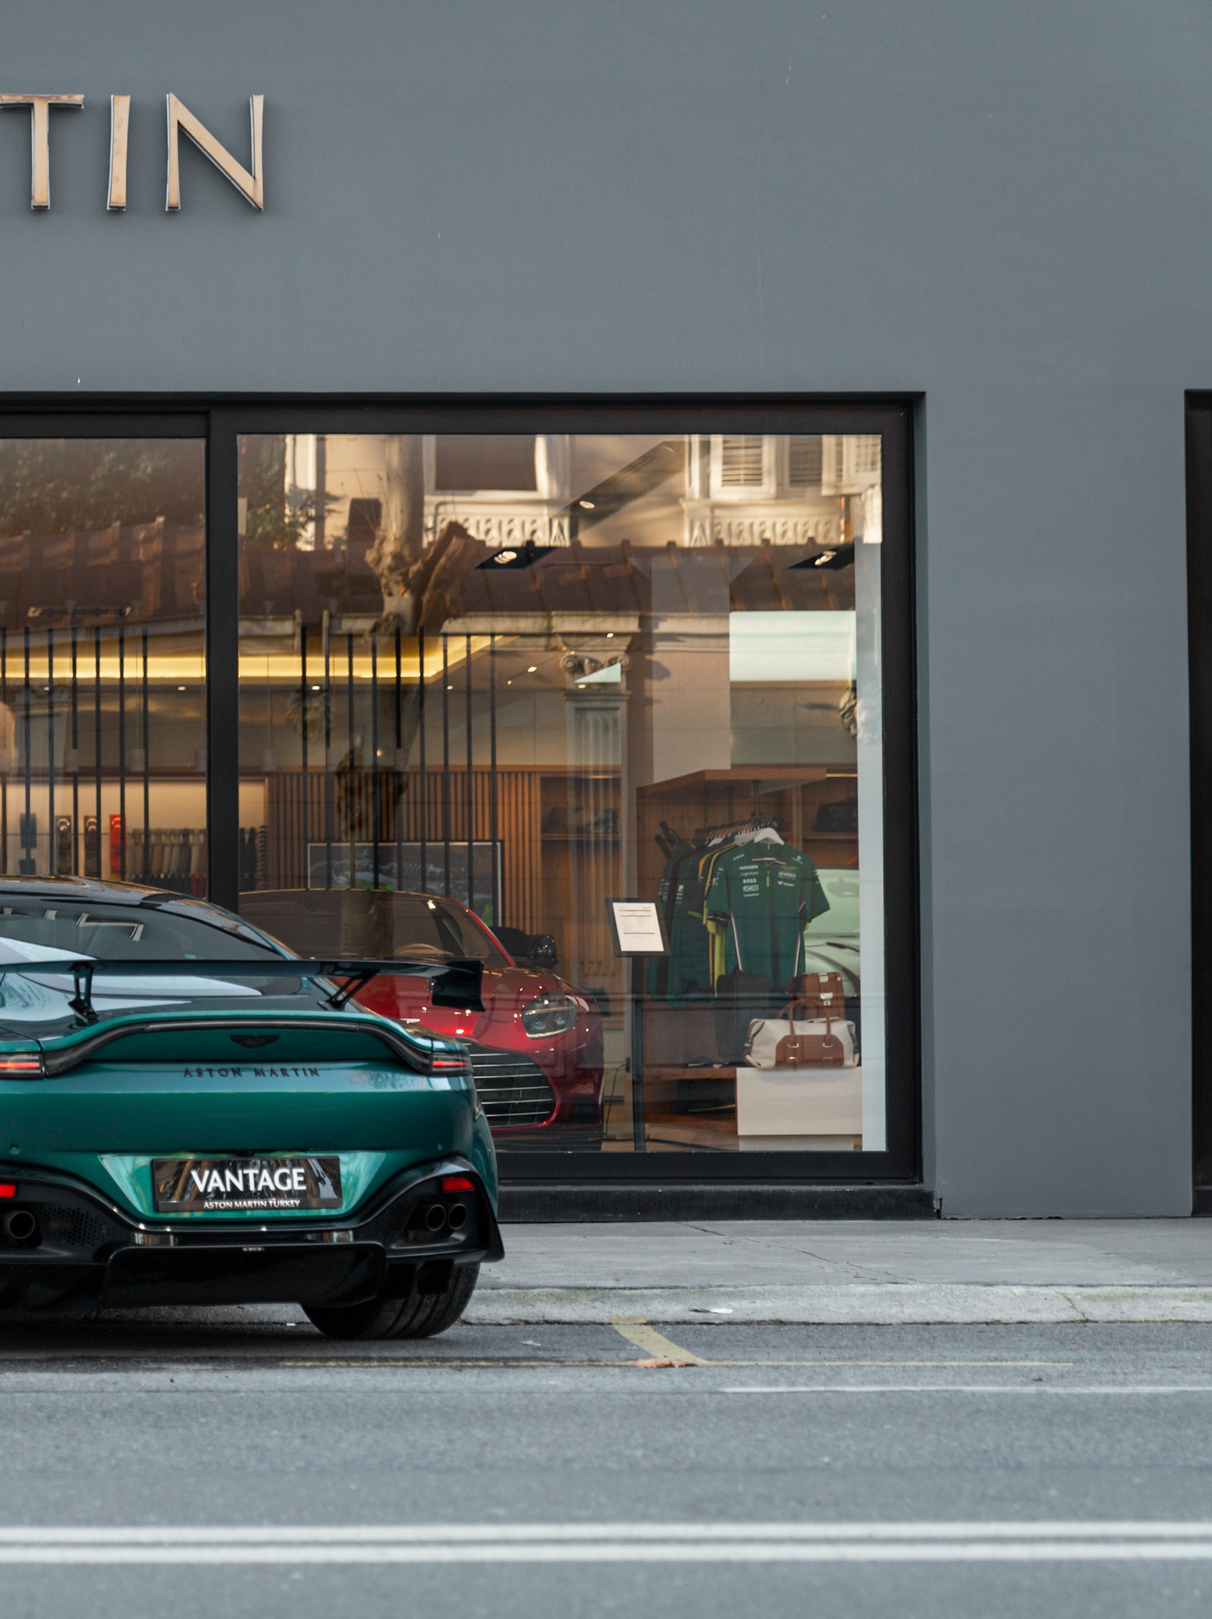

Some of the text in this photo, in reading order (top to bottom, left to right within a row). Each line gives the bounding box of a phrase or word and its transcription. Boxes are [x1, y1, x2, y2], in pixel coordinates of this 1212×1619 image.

[183, 1067, 320, 1077] ASTON MARTIN
[191, 1168, 307, 1192] VANTAGE
[204, 1201, 233, 1209] ASTON
[269, 1199, 301, 1208] TURKEY
